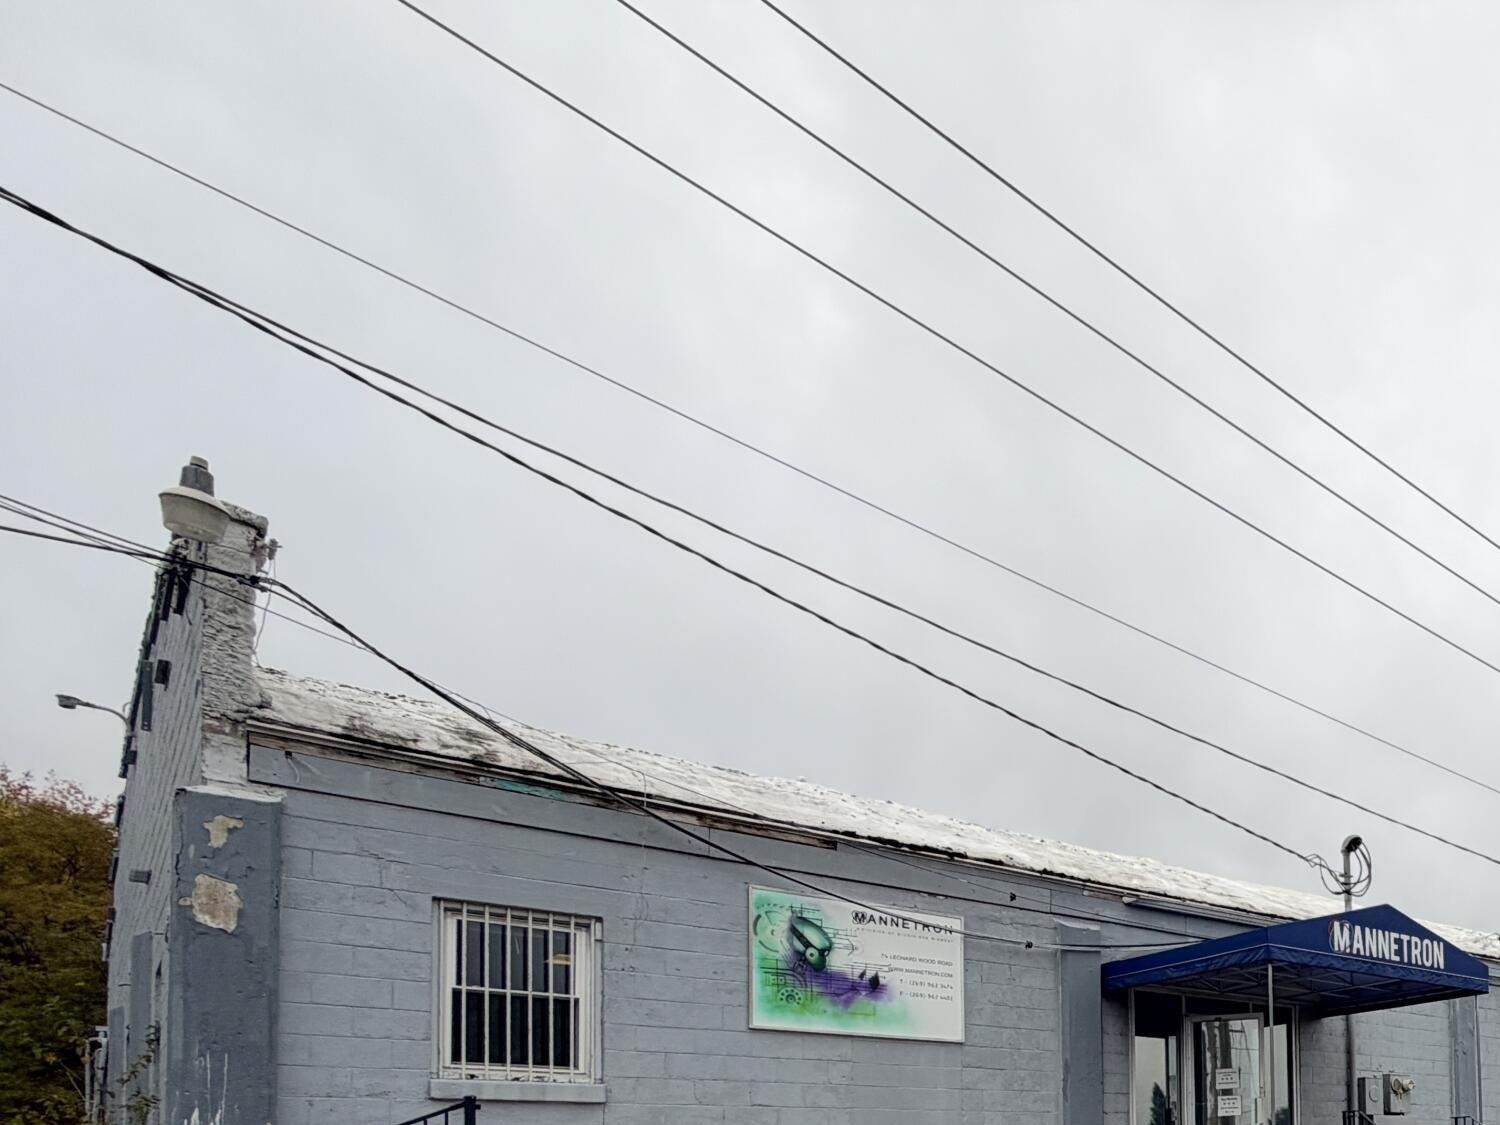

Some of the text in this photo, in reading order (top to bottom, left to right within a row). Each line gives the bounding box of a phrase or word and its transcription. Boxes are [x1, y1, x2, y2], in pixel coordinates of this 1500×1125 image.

[853, 911, 953, 935] MANNETRON
[1332, 920, 1445, 970] MANNETRON
[889, 954, 918, 963] LEONARD
[918, 957, 936, 965] WOOD
[937, 959, 954, 967] ROAD
